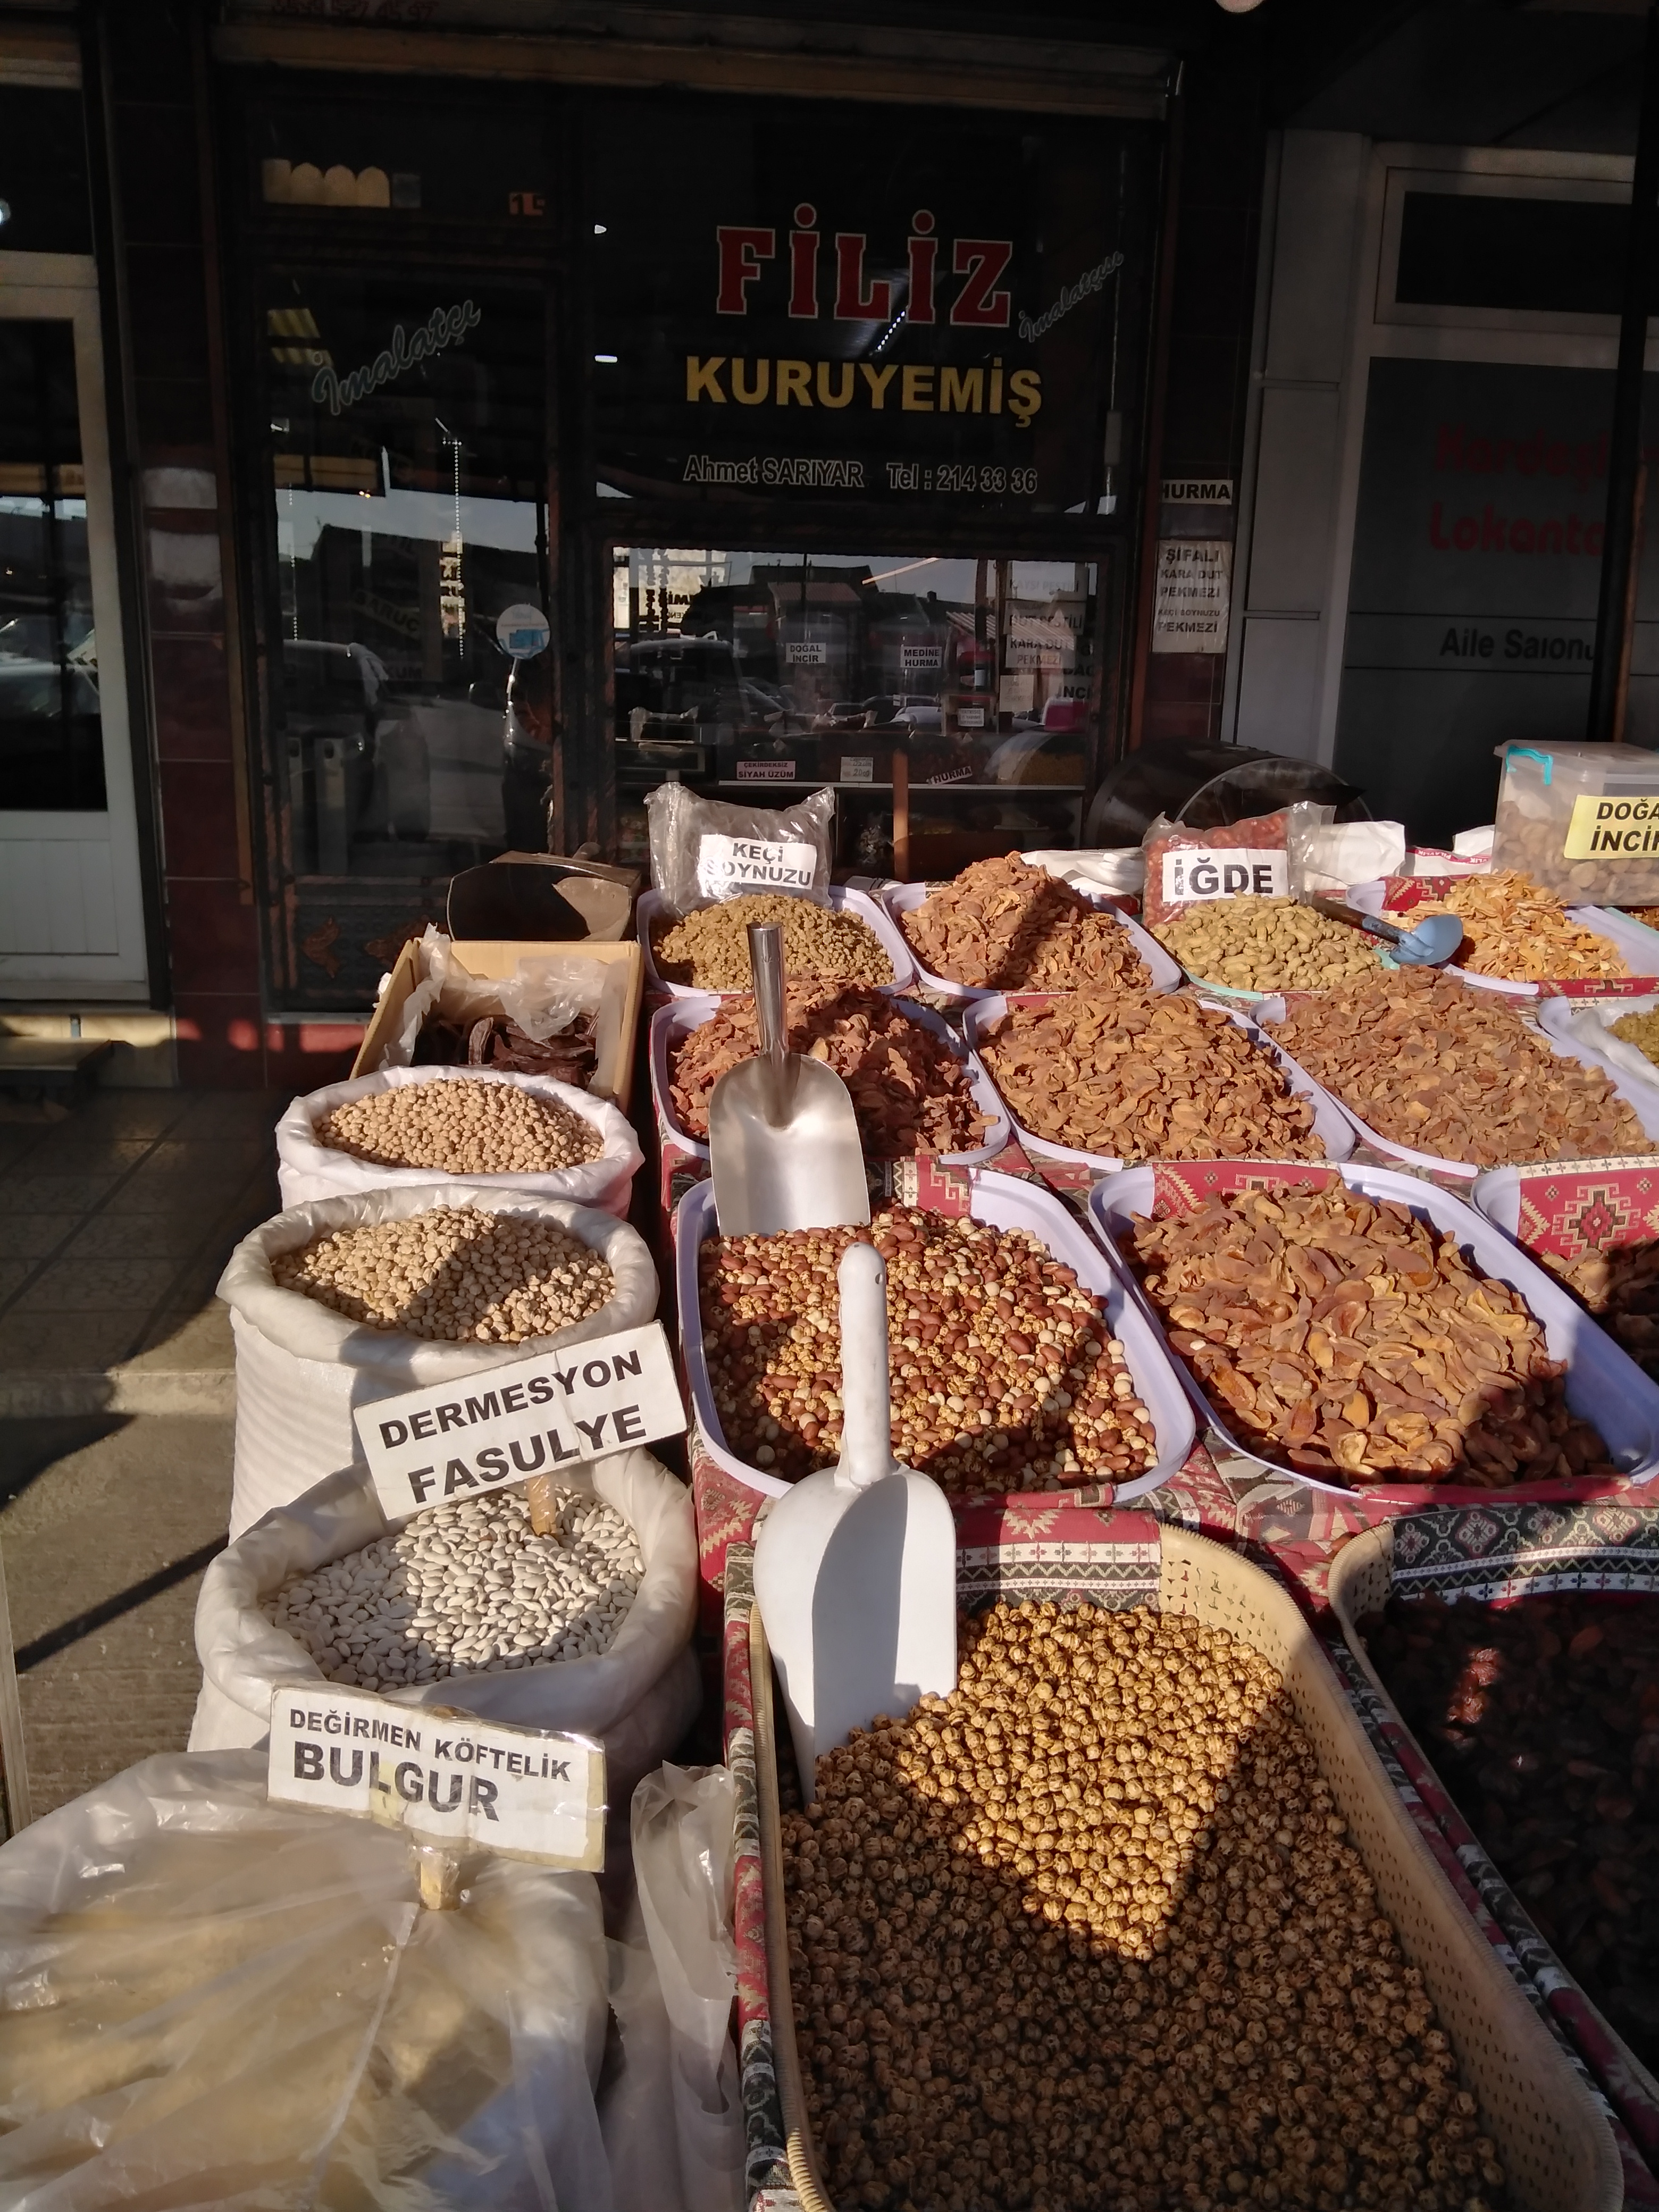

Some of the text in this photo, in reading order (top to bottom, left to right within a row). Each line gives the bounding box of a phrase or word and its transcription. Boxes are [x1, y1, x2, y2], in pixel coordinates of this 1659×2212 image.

[716, 202, 1013, 328] FİLİZ
[312, 299, 482, 416] İmalatçı
[686, 355, 1042, 428] KURUYEMİŞ
[683, 454, 758, 483] Ahmet
[761, 457, 865, 488] SARIYAR
[936, 465, 976, 492] 214
[980, 466, 1007, 493] 33
[1010, 467, 1038, 495] 36
[1166, 547, 1219, 564] ŞİFALI
[1160, 586, 1220, 599] PEKMEZİ
[793, 654, 819, 663] İNCİR
[904, 648, 940, 657] MEDİNE
[1439, 628, 1494, 658] Aile
[769, 769, 794, 778] ÜZÜM
[934, 767, 971, 784] HURMA
[1596, 798, 1659, 820] DOĞA
[732, 843, 784, 865] KEÇİ
[1174, 857, 1273, 895] İĞDE
[378, 1350, 643, 1449] DERMESYON
[407, 1404, 647, 1504] FASULYE
[290, 1708, 572, 1782] DEĞİRMEN KÖFTELİK
[294, 1741, 499, 1822] BULGUR
